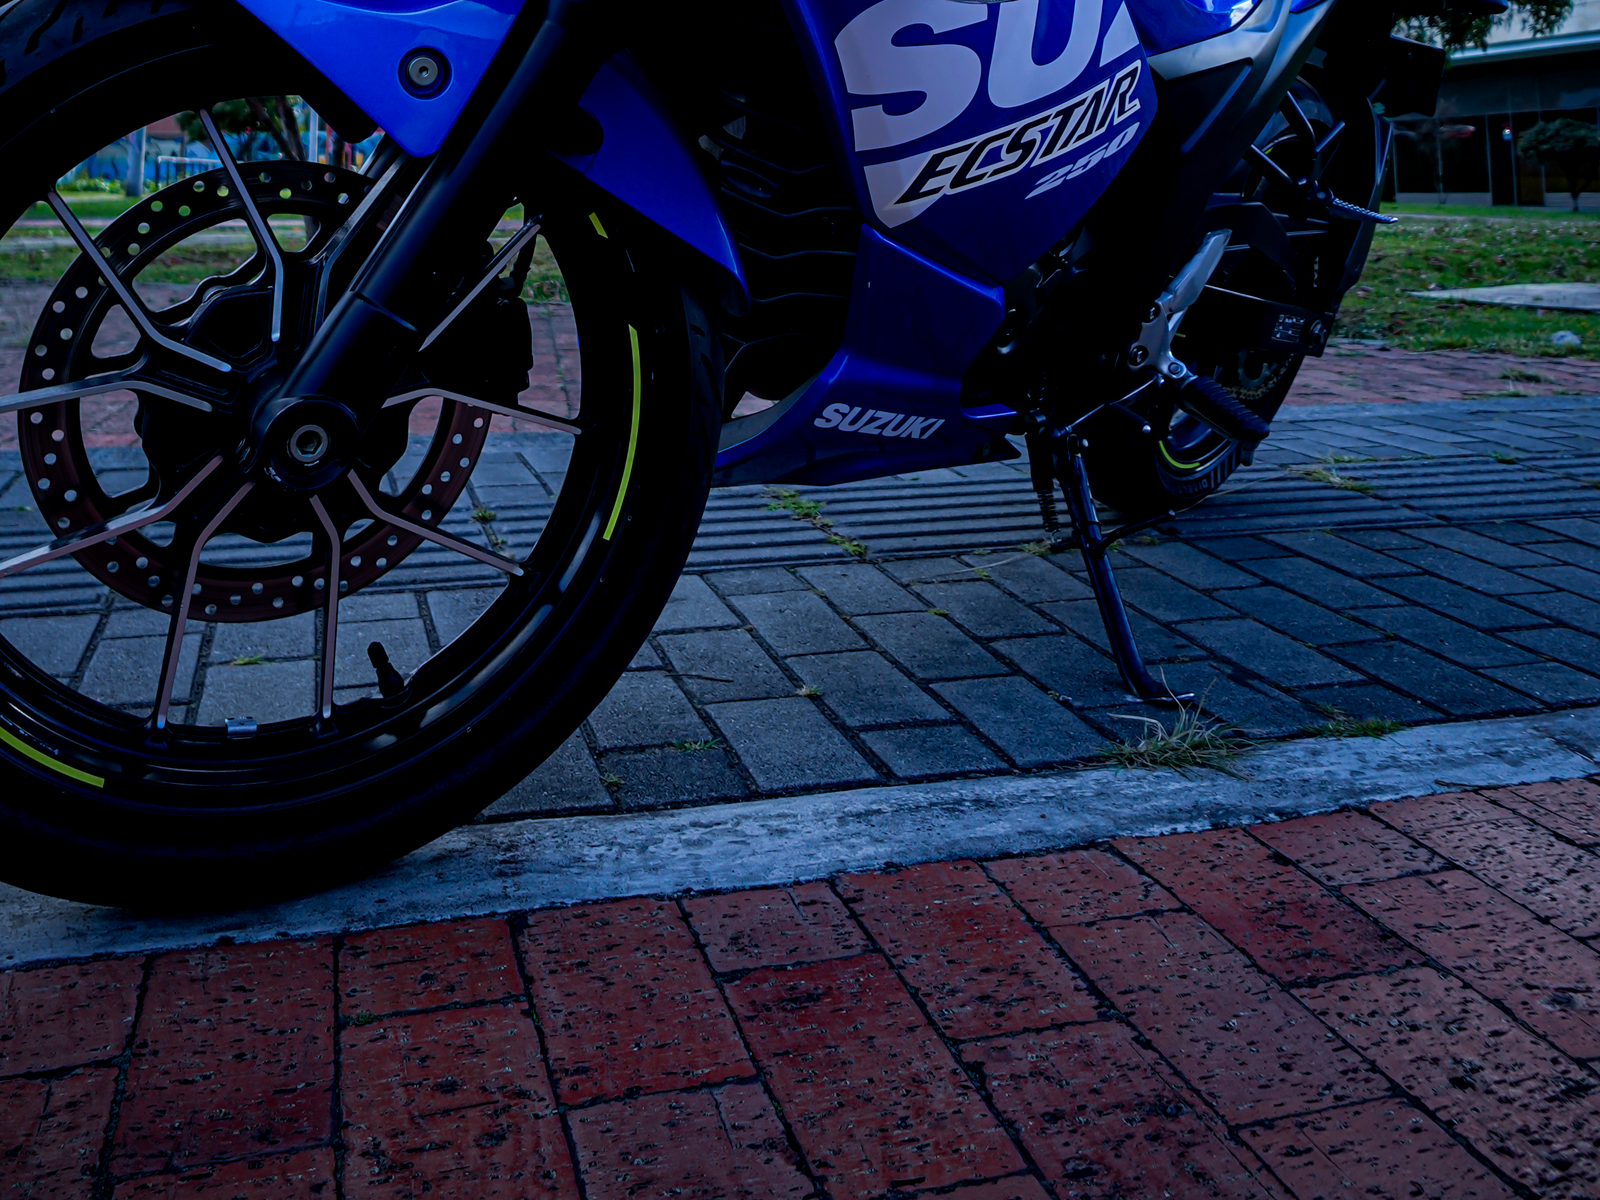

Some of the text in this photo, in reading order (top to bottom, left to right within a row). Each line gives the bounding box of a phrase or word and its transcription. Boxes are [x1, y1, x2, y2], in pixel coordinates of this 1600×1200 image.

[889, 62, 1141, 208] ECSTAR
[1024, 121, 1141, 200] 250
[813, 402, 946, 440] SUZUKI
